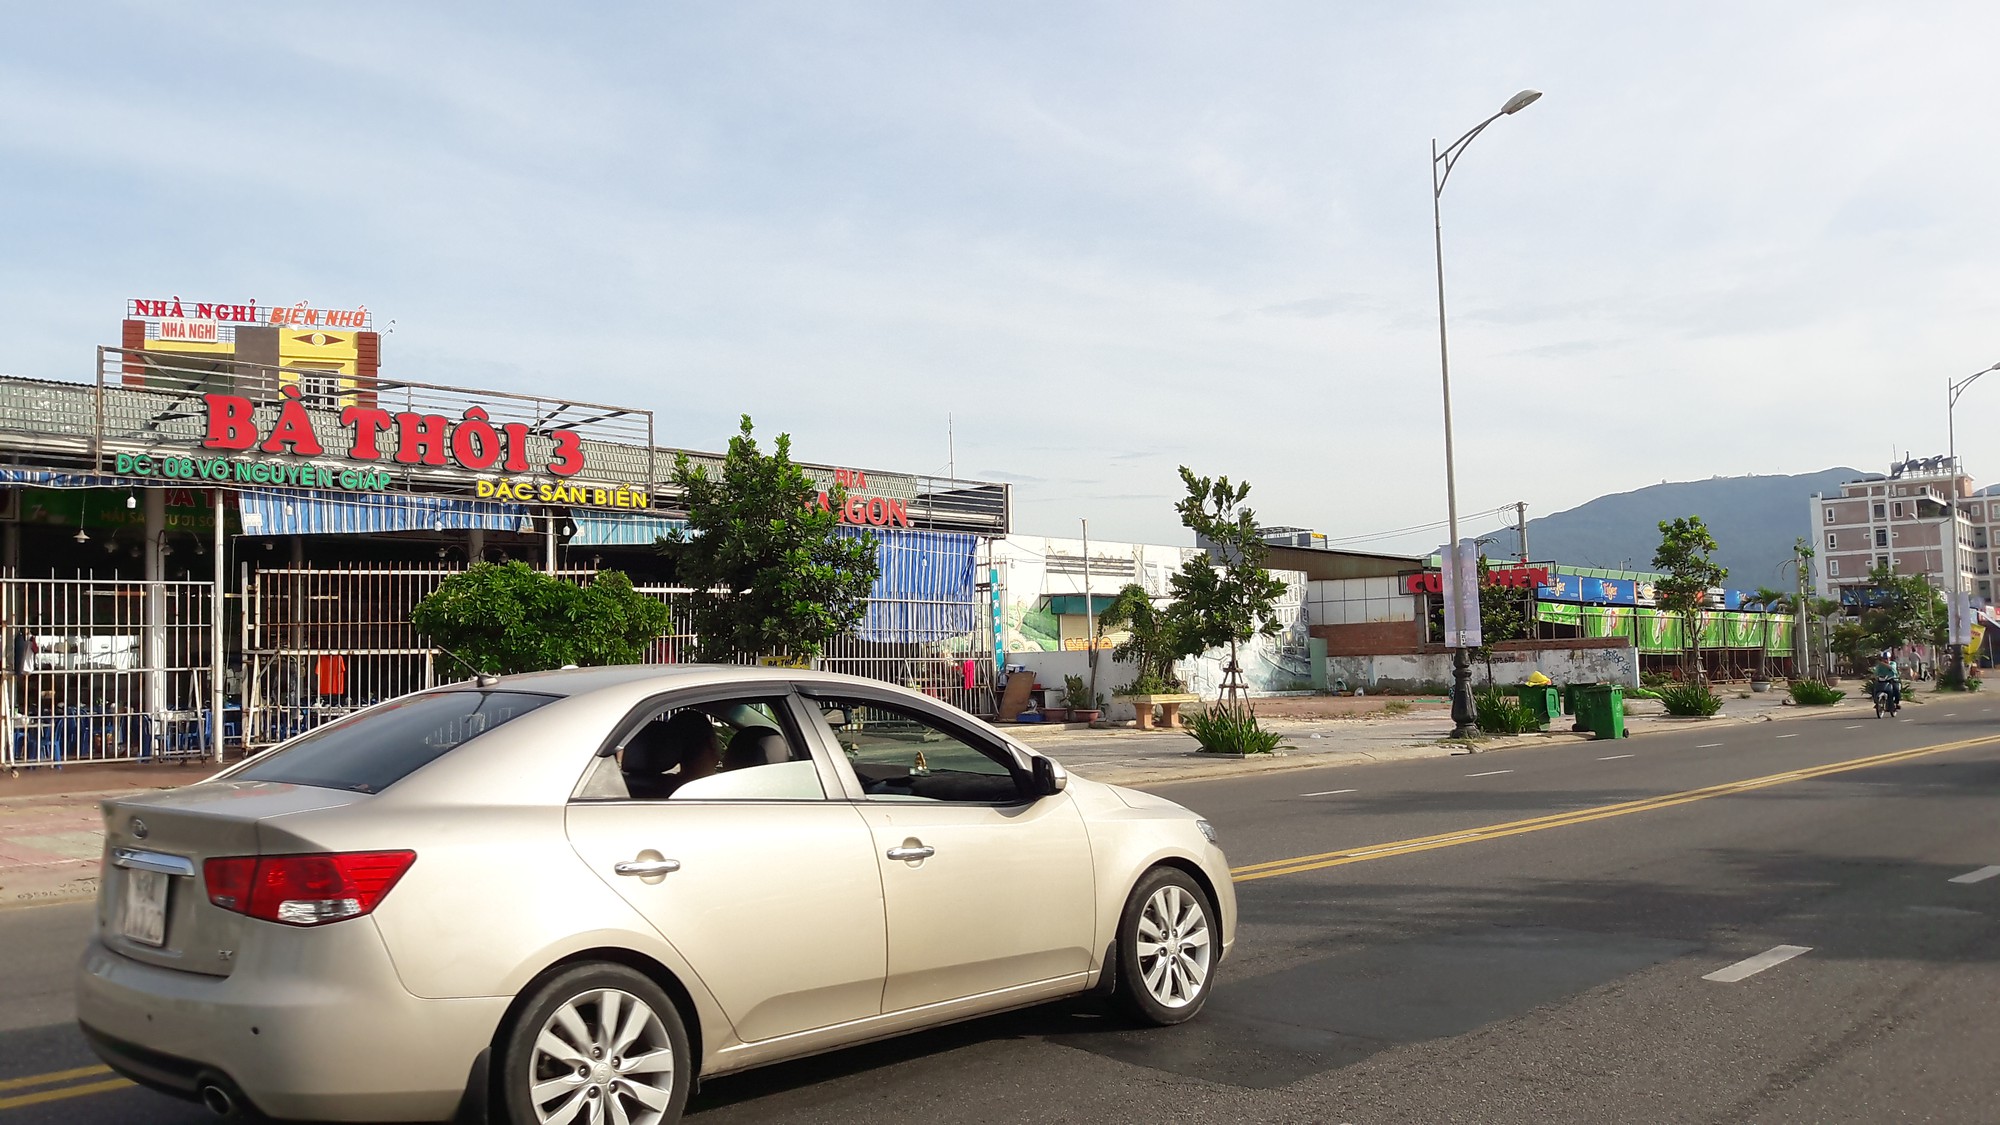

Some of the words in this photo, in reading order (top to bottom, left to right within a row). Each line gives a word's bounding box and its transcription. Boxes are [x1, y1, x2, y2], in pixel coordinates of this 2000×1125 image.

[134, 296, 184, 318] NHÀ
[197, 298, 256, 322] NGHỈ
[269, 300, 319, 325] BIỂN
[161, 320, 186, 338] NHÀ
[188, 319, 216, 339] NGHỈ
[201, 384, 323, 455] BÀ
[340, 405, 530, 473] THÔI
[547, 430, 585, 476] 3
[163, 457, 194, 478] 08
[196, 456, 230, 480] VÕ
[235, 462, 333, 489] NGUYÊN
[339, 467, 392, 490] GIÁP
[835, 468, 867, 489] BIA
[476, 477, 533, 503] ĐẶC
[539, 479, 587, 505] SẢN
[594, 483, 648, 509] BIỂN
